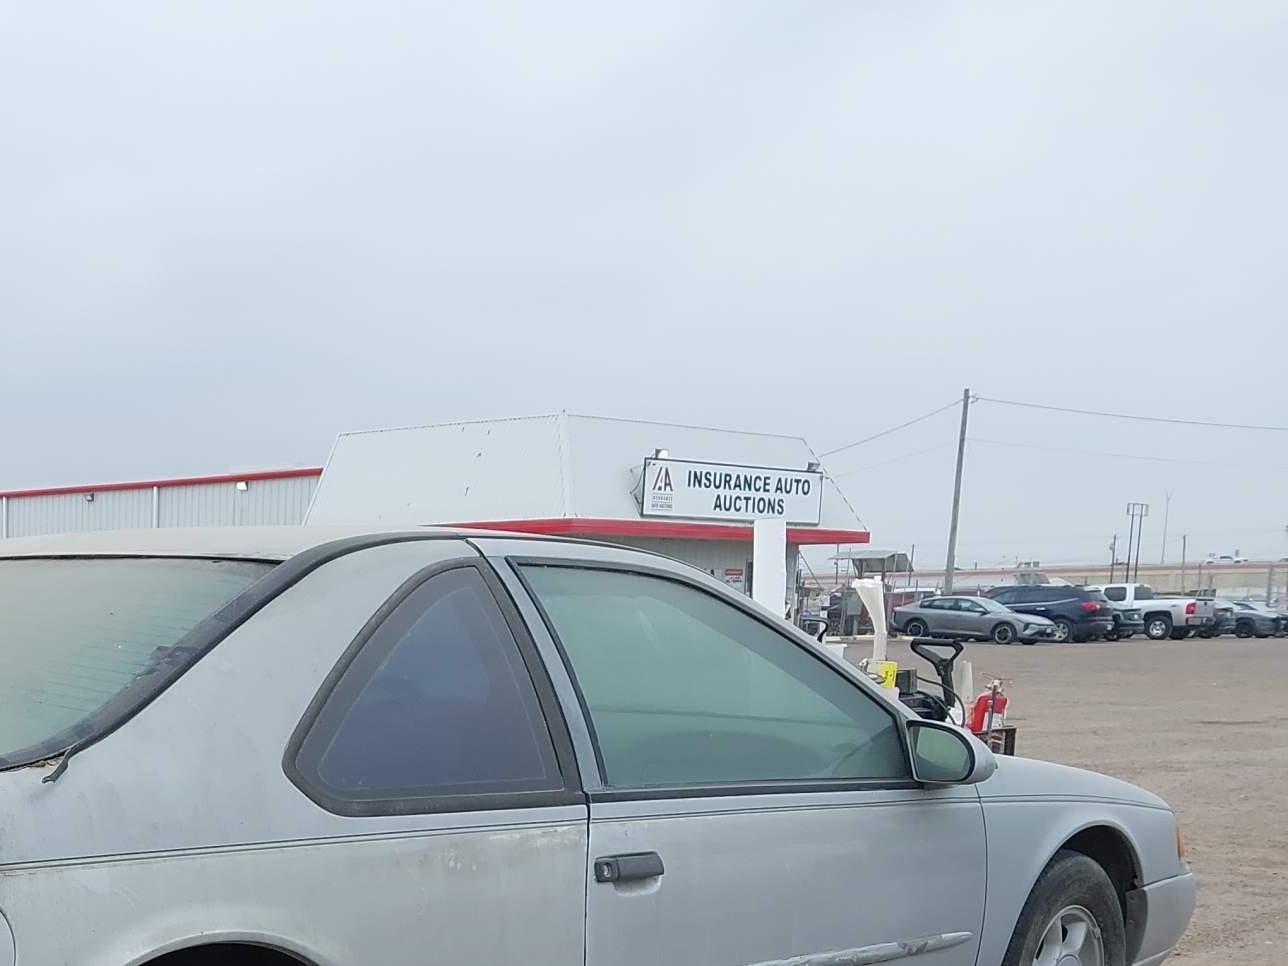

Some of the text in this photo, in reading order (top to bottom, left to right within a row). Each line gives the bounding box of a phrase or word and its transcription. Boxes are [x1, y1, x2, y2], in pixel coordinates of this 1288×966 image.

[687, 469, 811, 496] INSURANCE AUTO
[713, 494, 785, 515] AUCTIONS
